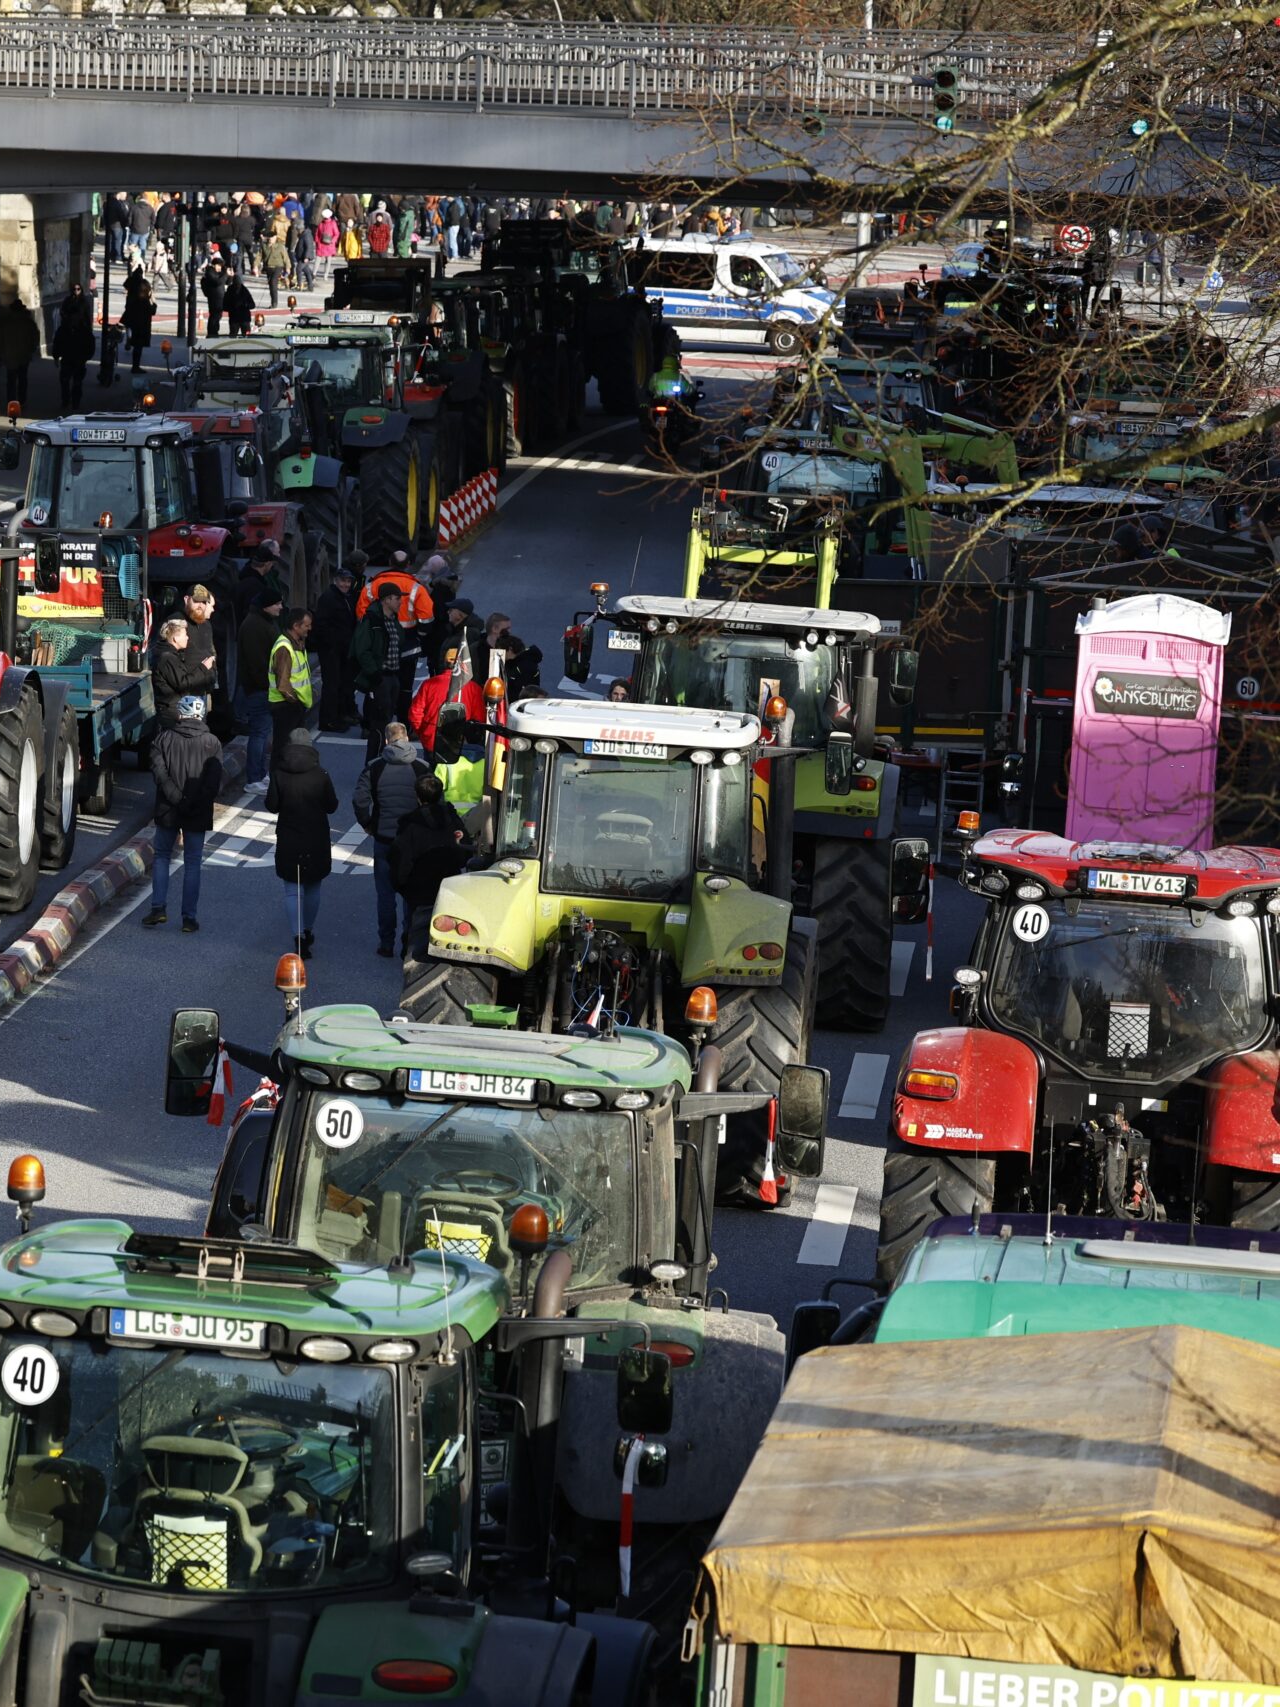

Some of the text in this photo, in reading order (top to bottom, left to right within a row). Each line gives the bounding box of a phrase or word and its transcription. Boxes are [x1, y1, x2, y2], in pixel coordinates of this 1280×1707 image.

[79, 430, 124, 440] ROW TF 114
[765, 455, 778, 469] 40
[33, 508, 44, 521] 40
[63, 552, 93, 561] IN DER
[724, 622, 762, 630] CLAAS
[614, 631, 626, 640] WL
[622, 641, 639, 649] 282
[1240, 680, 1255, 696] 60
[600, 728, 655, 741] CLAAS
[592, 741, 665, 757] STD JL 641
[1098, 873, 1119, 889] WL
[1130, 875, 1151, 891] TV
[1154, 877, 1184, 893] 613
[1019, 911, 1043, 936] 40
[429, 1070, 456, 1091] LG
[469, 1076, 497, 1094] JH
[501, 1079, 526, 1096] 84
[326, 1108, 353, 1140] 50
[135, 1310, 167, 1335] LG
[185, 1316, 217, 1340] JU
[224, 1320, 254, 1342] 95
[13, 1356, 46, 1394] 40
[934, 1668, 1080, 1707] LIEBER
